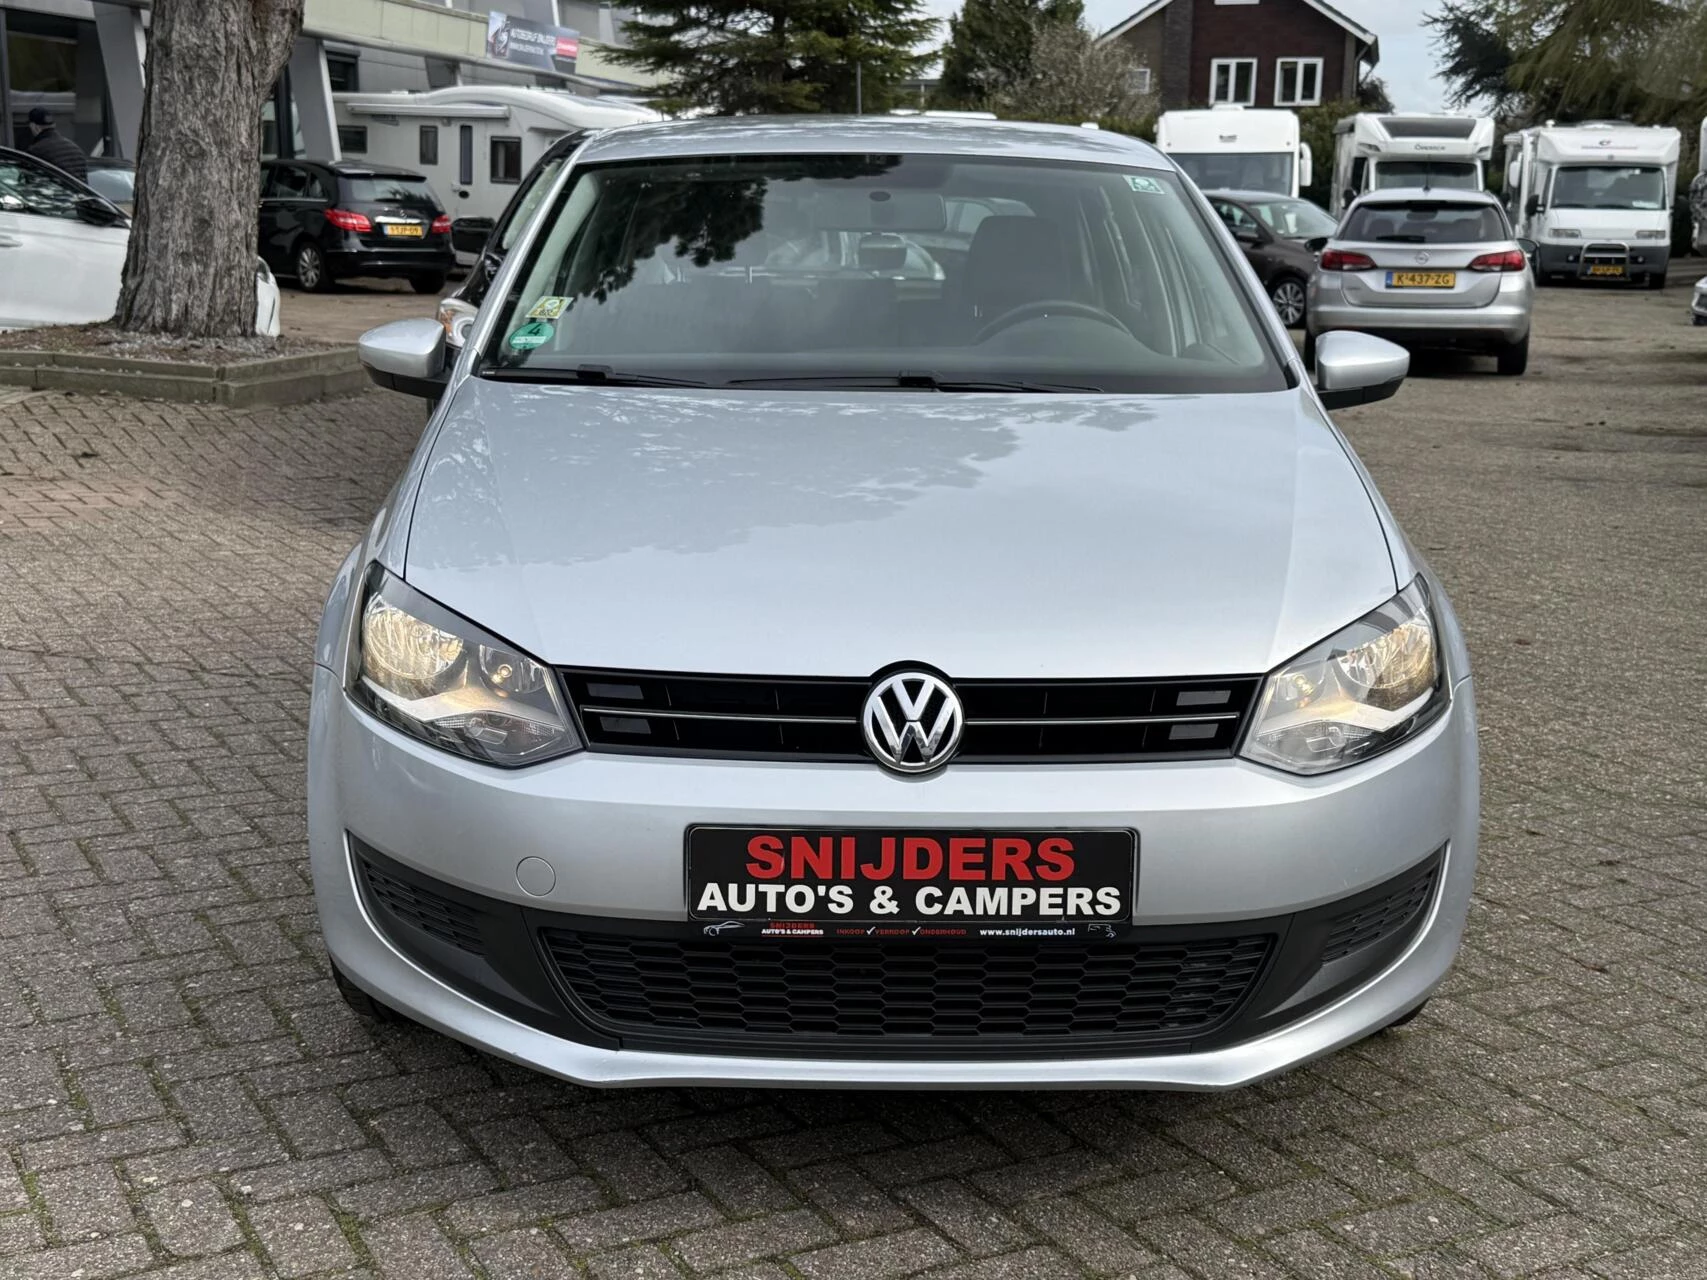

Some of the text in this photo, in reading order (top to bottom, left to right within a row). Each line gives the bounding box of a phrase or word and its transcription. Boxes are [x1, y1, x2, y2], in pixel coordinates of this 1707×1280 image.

[528, 323, 542, 336] 4
[746, 835, 1075, 881] SNIJDERS
[697, 882, 1121, 916] AUTO'S & CAMPERS
[980, 928, 1075, 937] www.snijdersauto.nl
